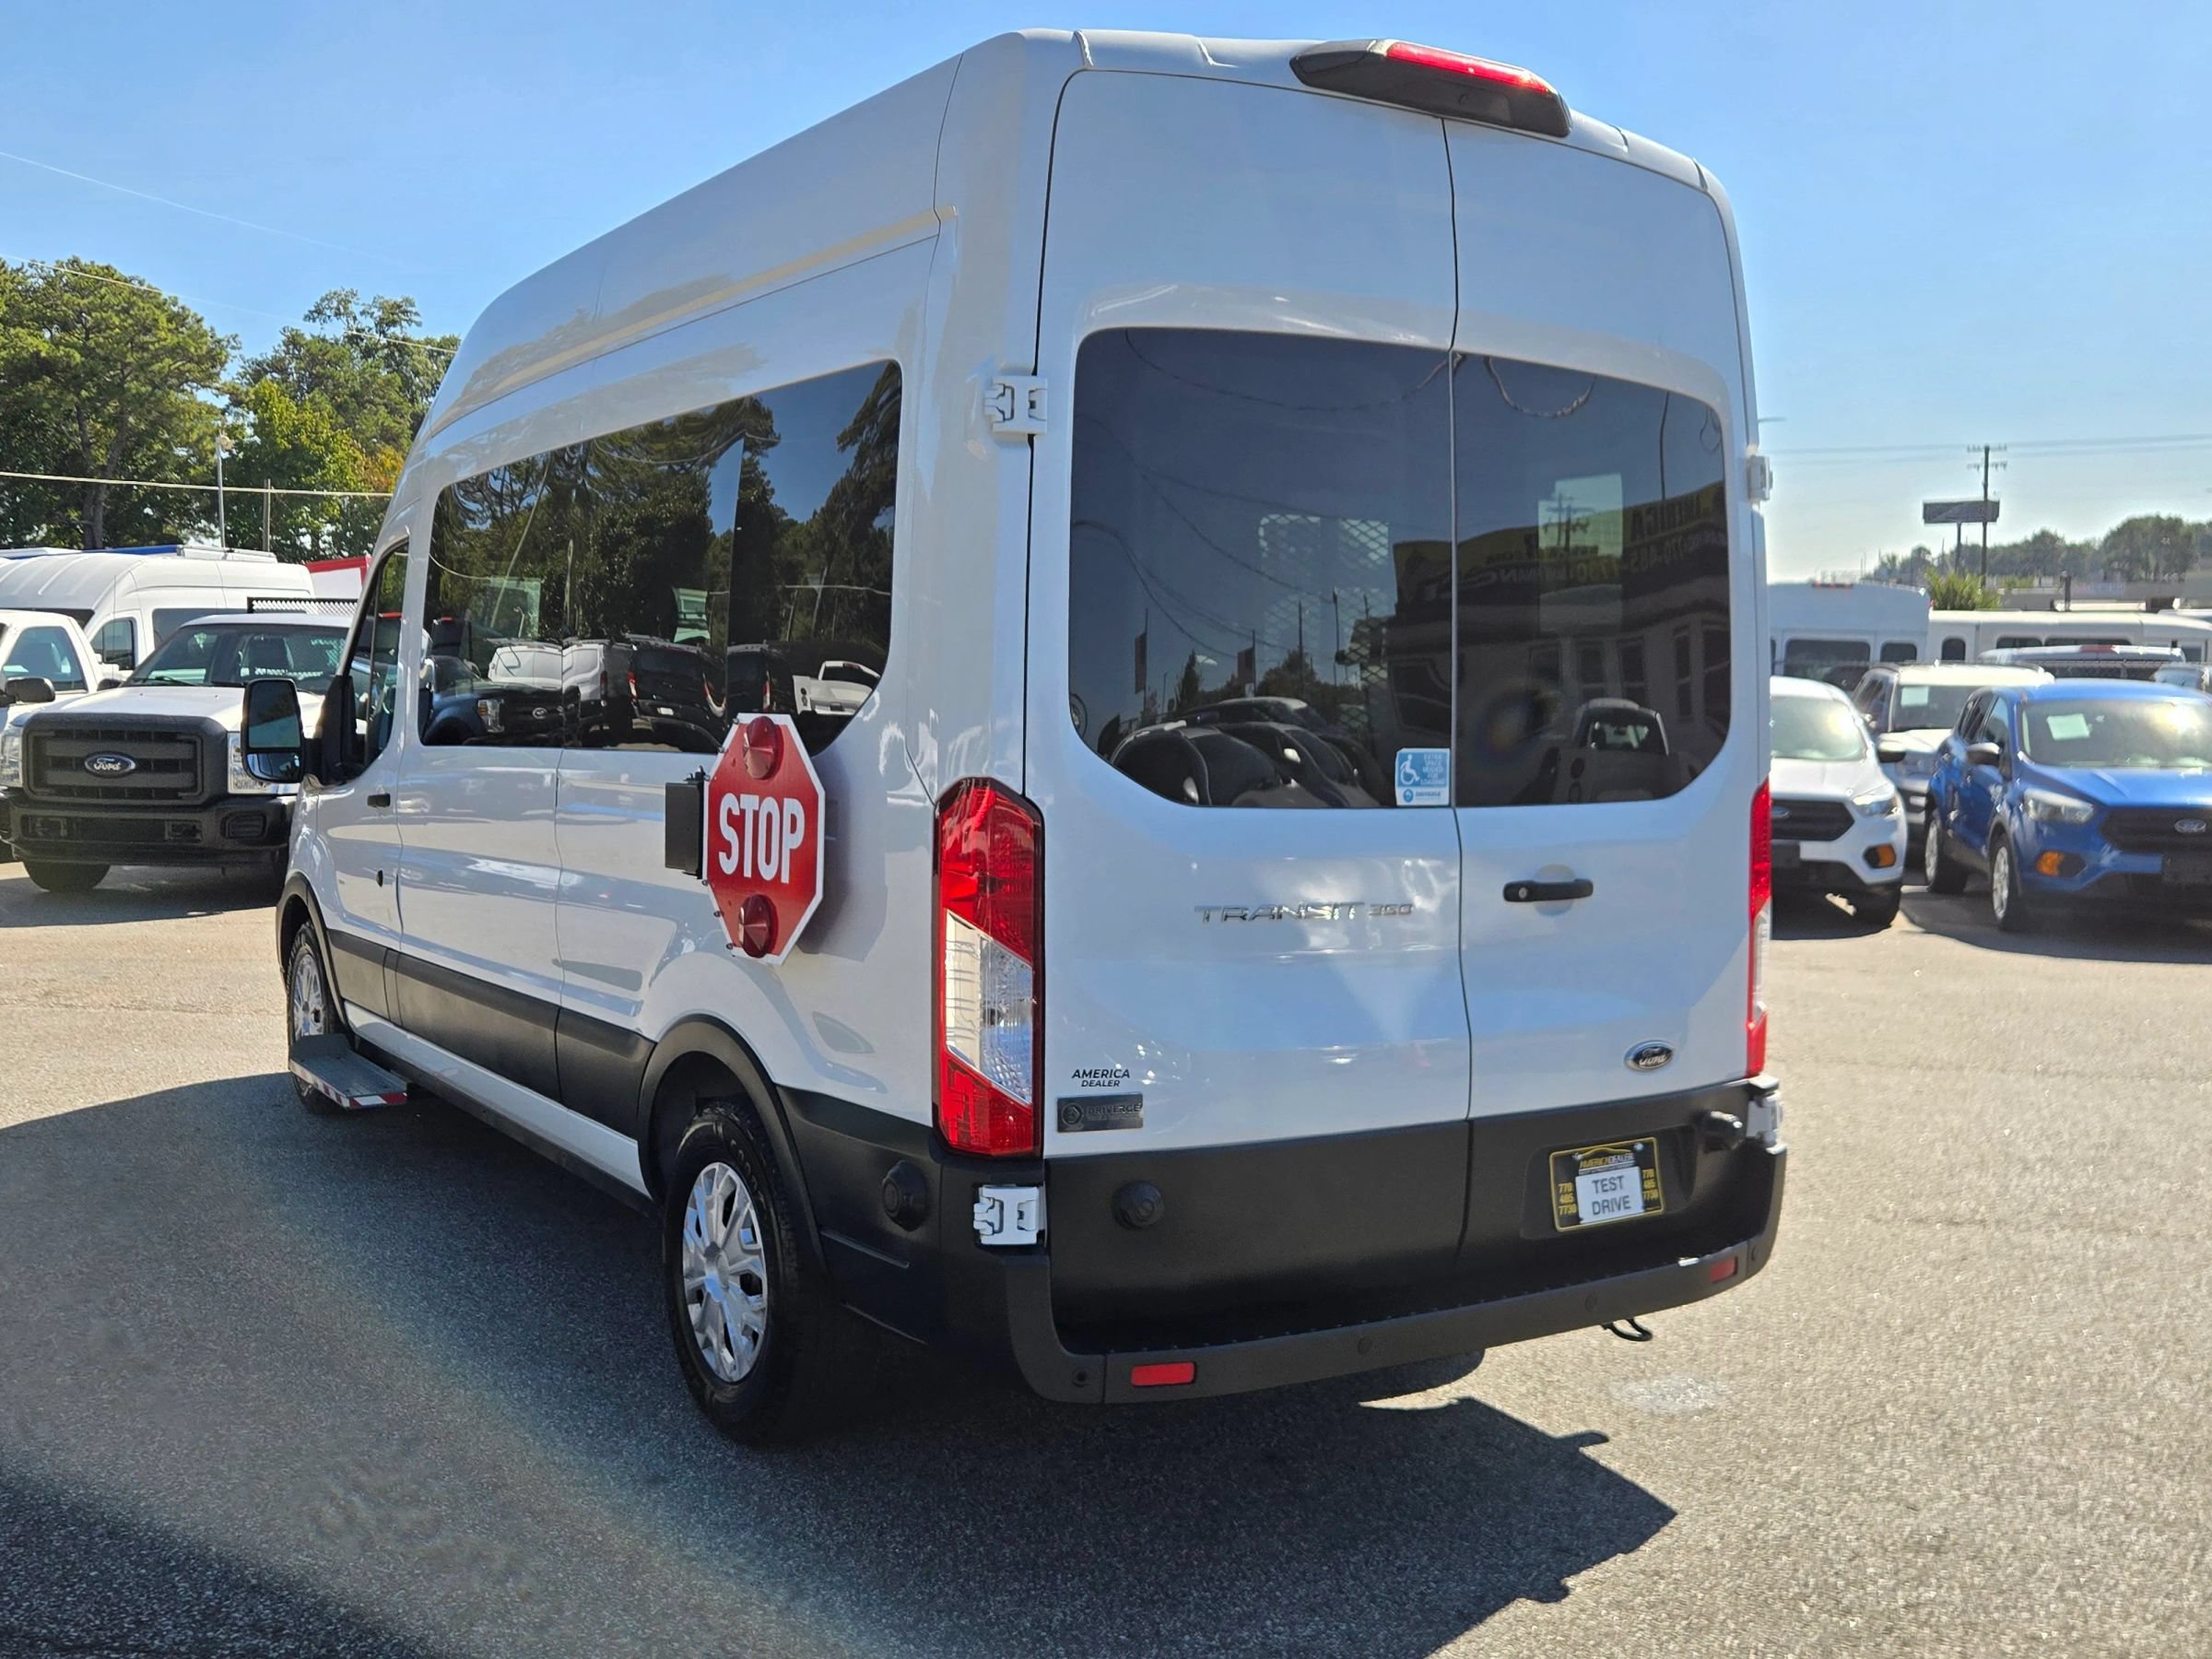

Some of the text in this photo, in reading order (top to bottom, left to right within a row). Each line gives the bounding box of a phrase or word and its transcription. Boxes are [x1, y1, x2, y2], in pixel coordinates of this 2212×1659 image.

[718, 793, 805, 884] STOP
[1194, 901, 1413, 924] TRANSIT 350
[1071, 1068, 1131, 1079] AMERICA
[1081, 1079, 1121, 1088] DEALER
[1592, 1175, 1625, 1194] TEST
[1592, 1195, 1631, 1216] DRIVE
